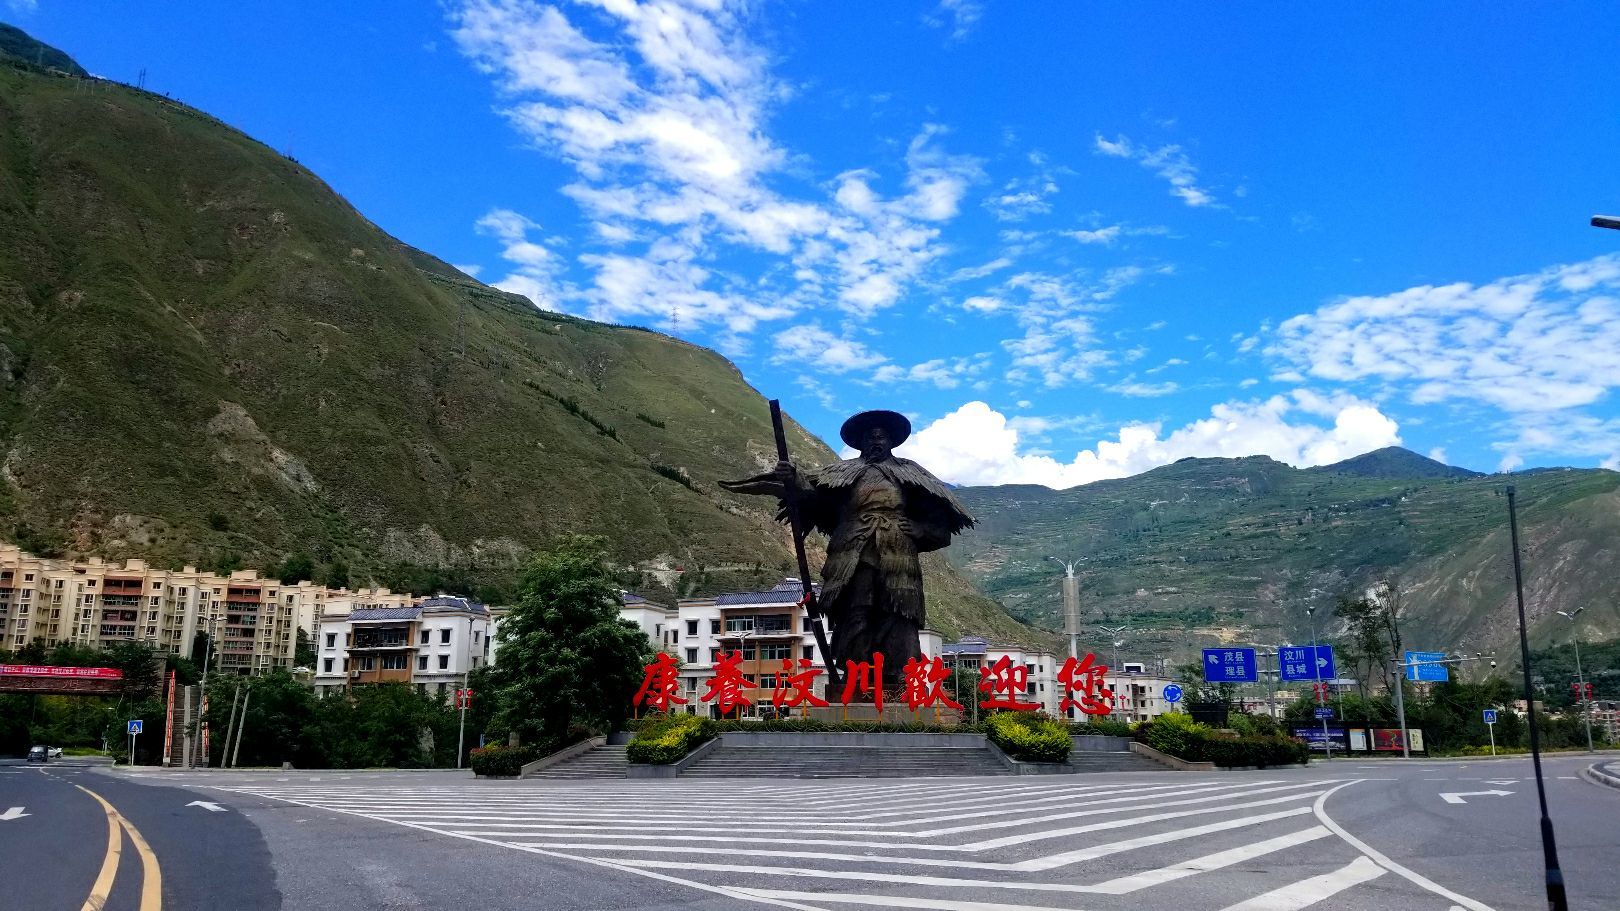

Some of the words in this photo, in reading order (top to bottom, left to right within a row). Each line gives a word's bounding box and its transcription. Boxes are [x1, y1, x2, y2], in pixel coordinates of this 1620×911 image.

[1223, 651, 1245, 662] 茂县
[1283, 649, 1305, 661] 汶川
[1224, 665, 1247, 676] 理县
[1285, 664, 1307, 675] 县城
